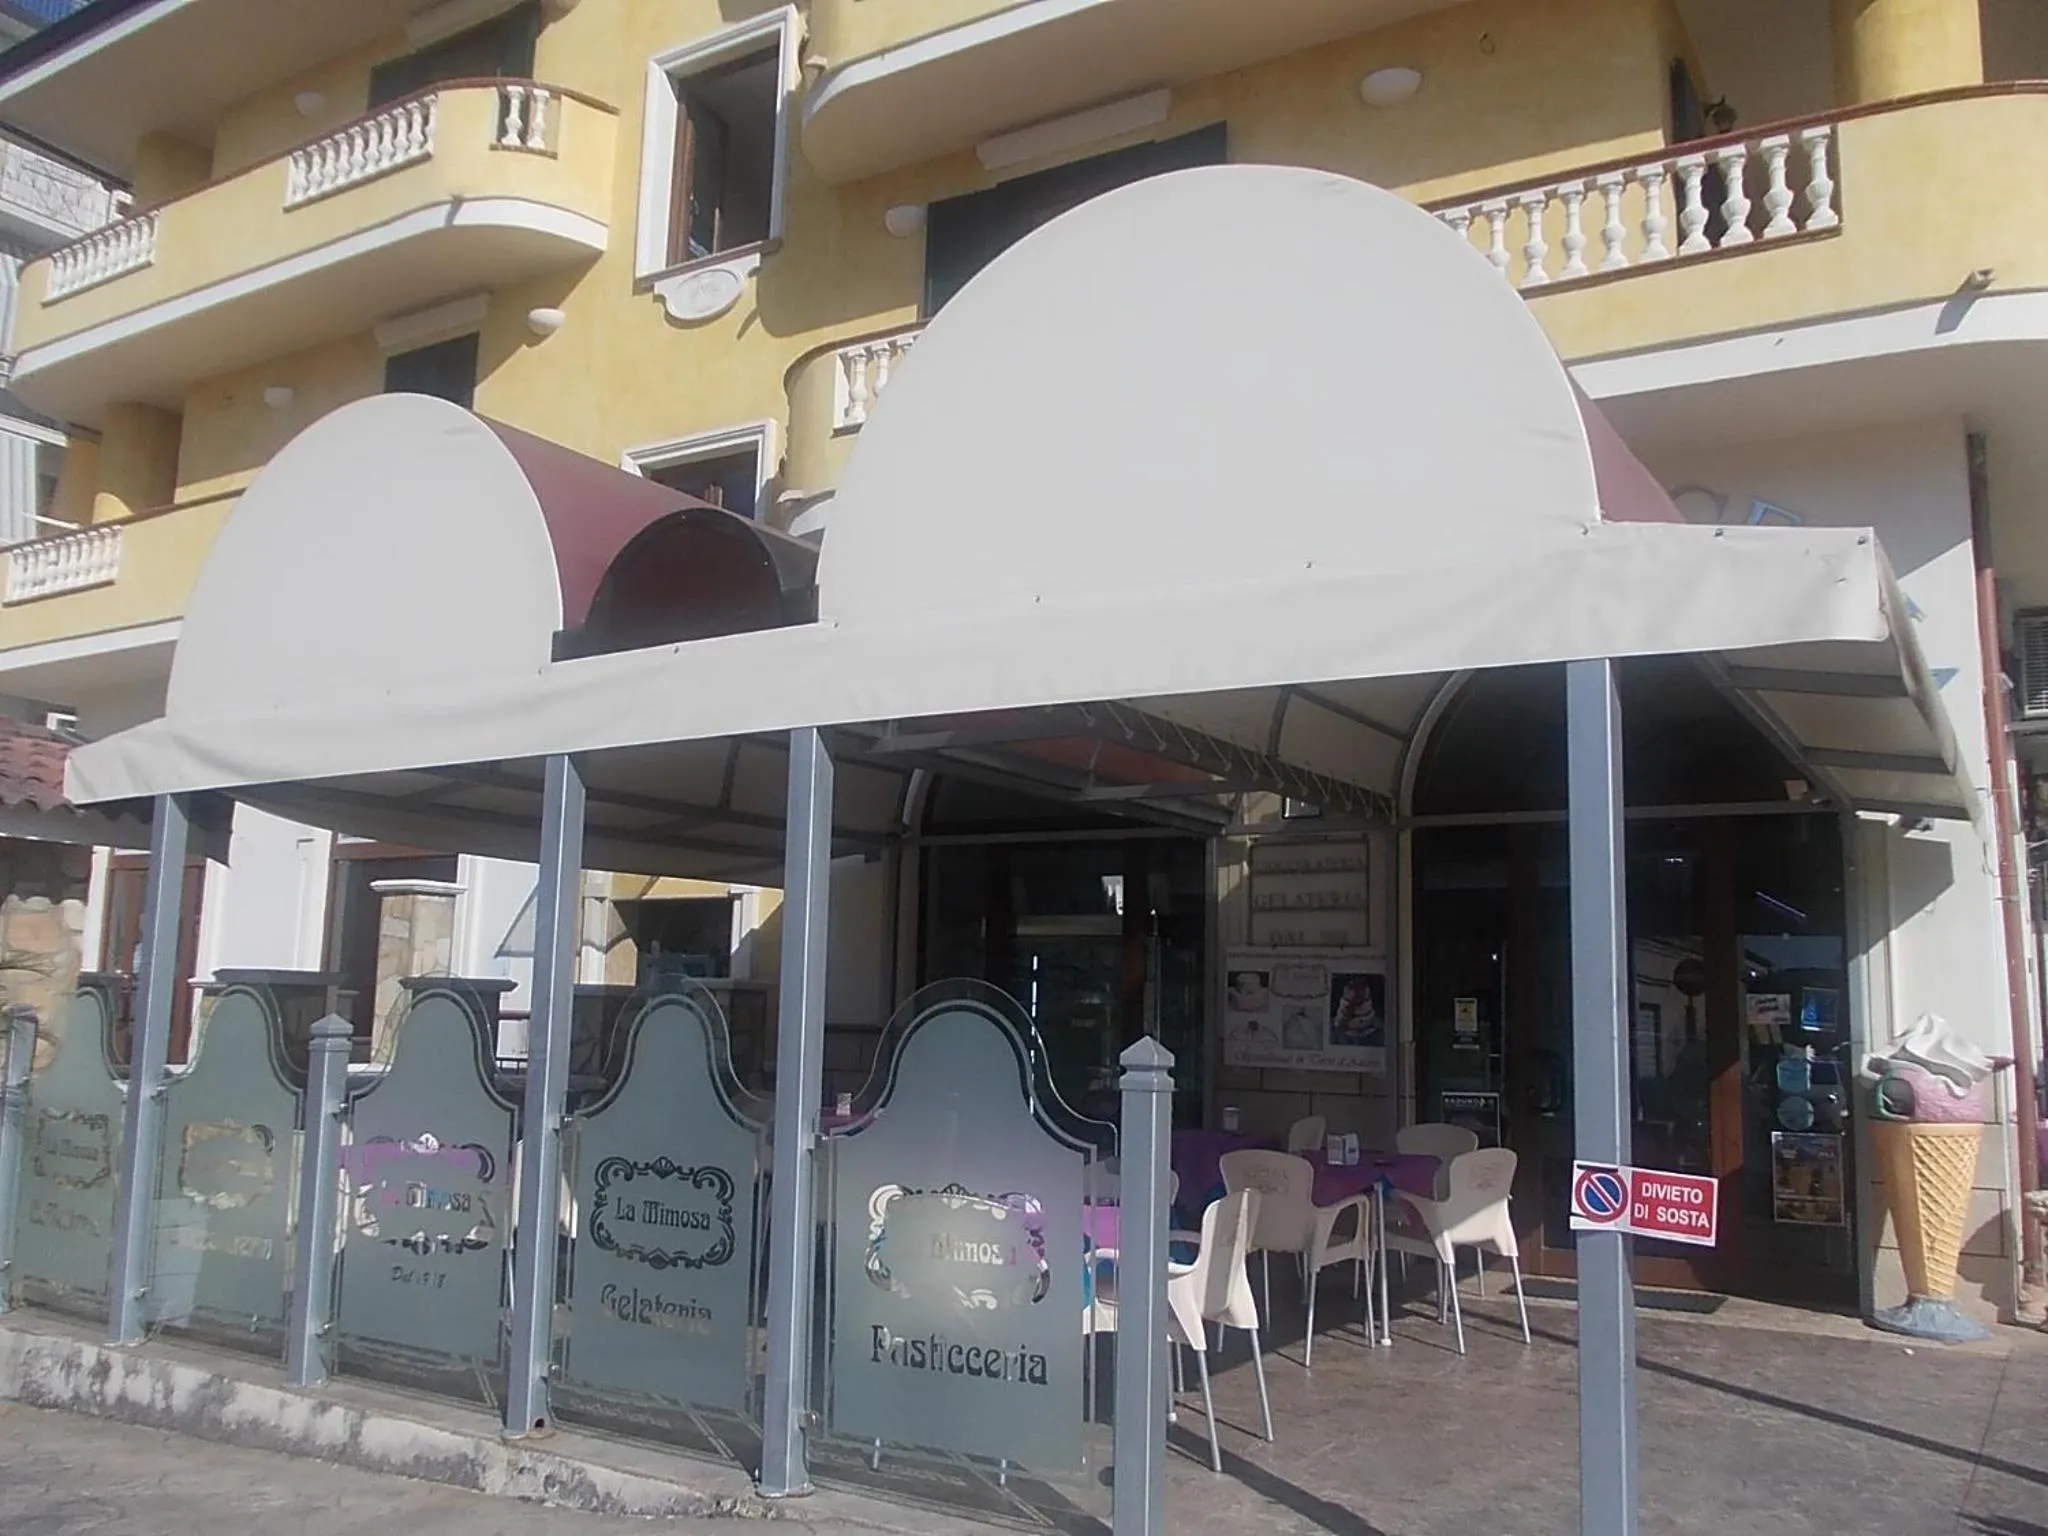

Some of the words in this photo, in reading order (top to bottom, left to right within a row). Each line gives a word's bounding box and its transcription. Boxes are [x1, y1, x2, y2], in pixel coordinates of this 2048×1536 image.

[1641, 1182, 1704, 1204] DIVIETO
[614, 1197, 636, 1222] La
[642, 1199, 711, 1231] Mimosa
[1634, 1203, 1649, 1220] DI
[1656, 1206, 1710, 1228] SOSTA
[869, 1324, 1049, 1386] Pasticceria
